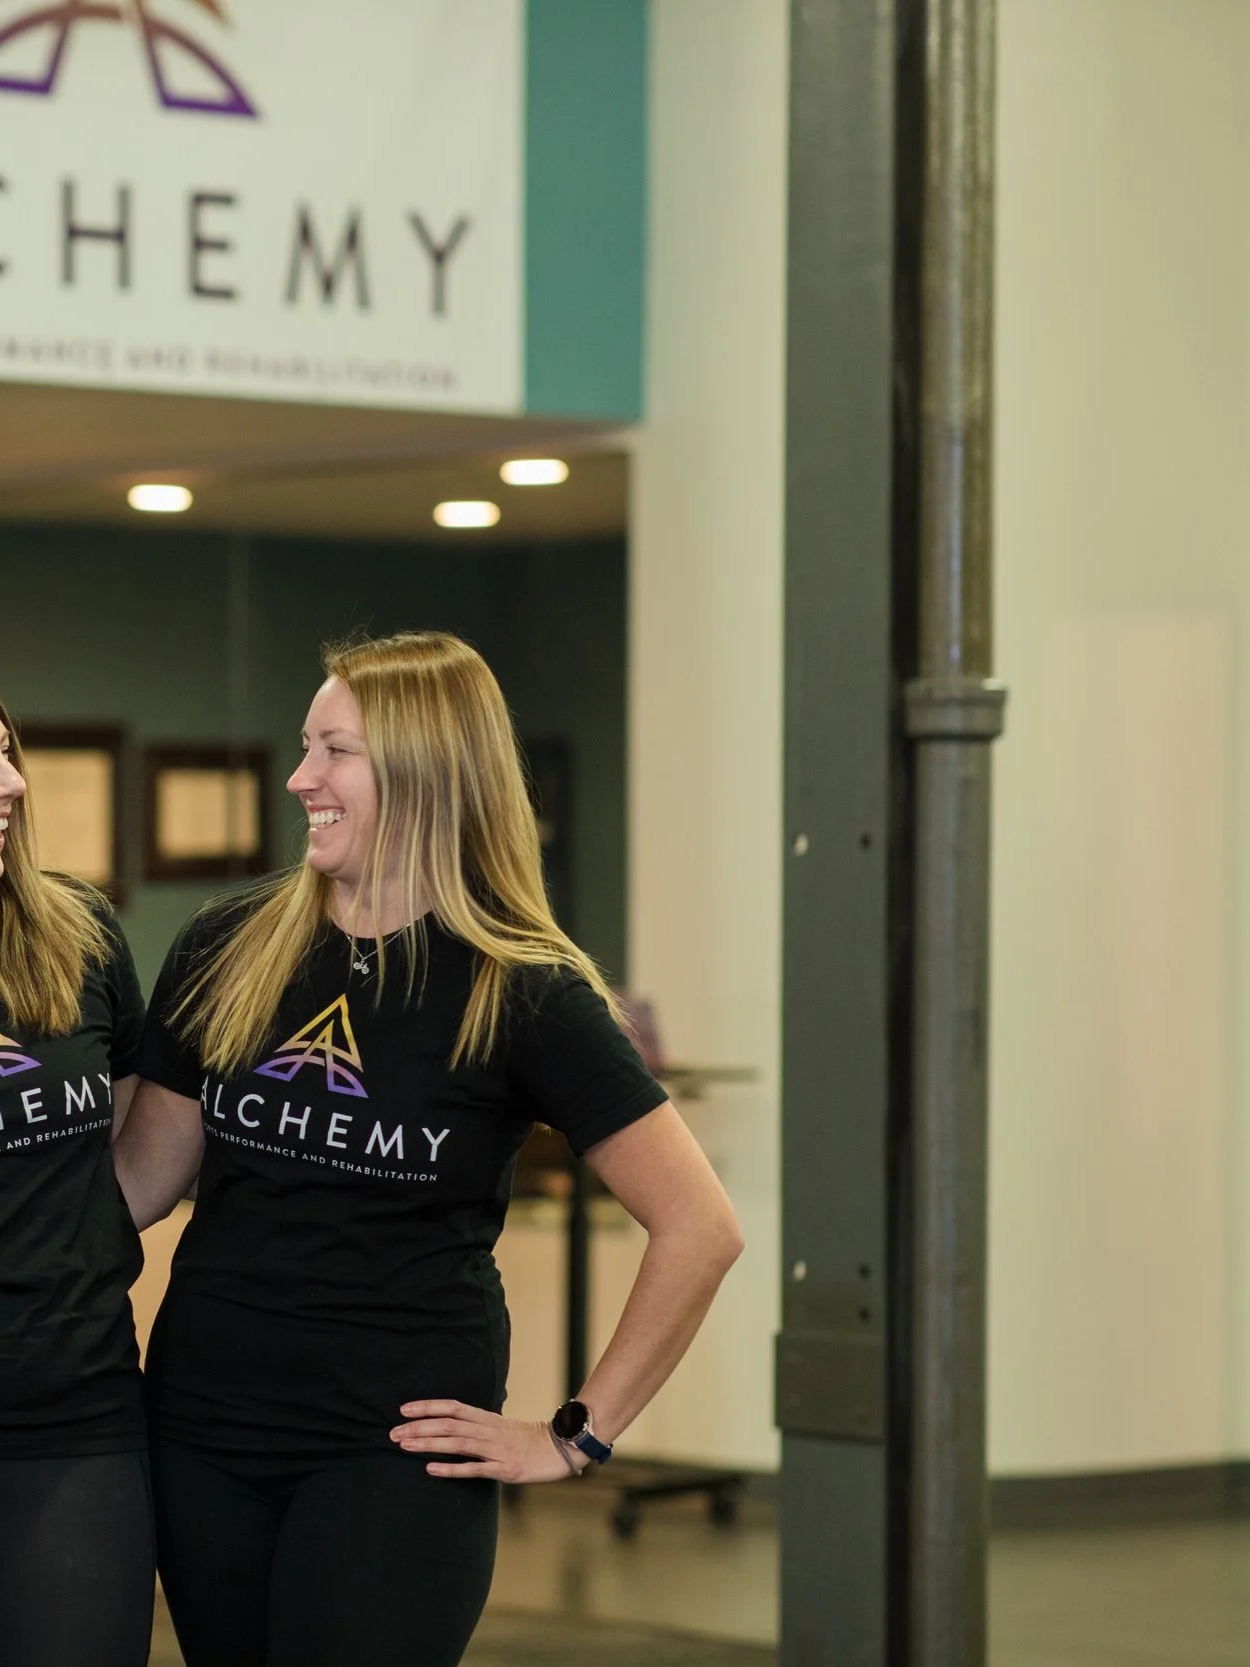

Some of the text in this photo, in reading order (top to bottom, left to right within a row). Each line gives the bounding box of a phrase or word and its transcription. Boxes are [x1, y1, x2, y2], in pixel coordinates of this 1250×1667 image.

[6, 1137, 31, 1150] AND
[200, 1074, 450, 1162] ALCHEMY
[220, 1131, 297, 1158] PERFORMANCE
[302, 1152, 326, 1164] AND
[332, 1159, 438, 1182] REHABILITATION
